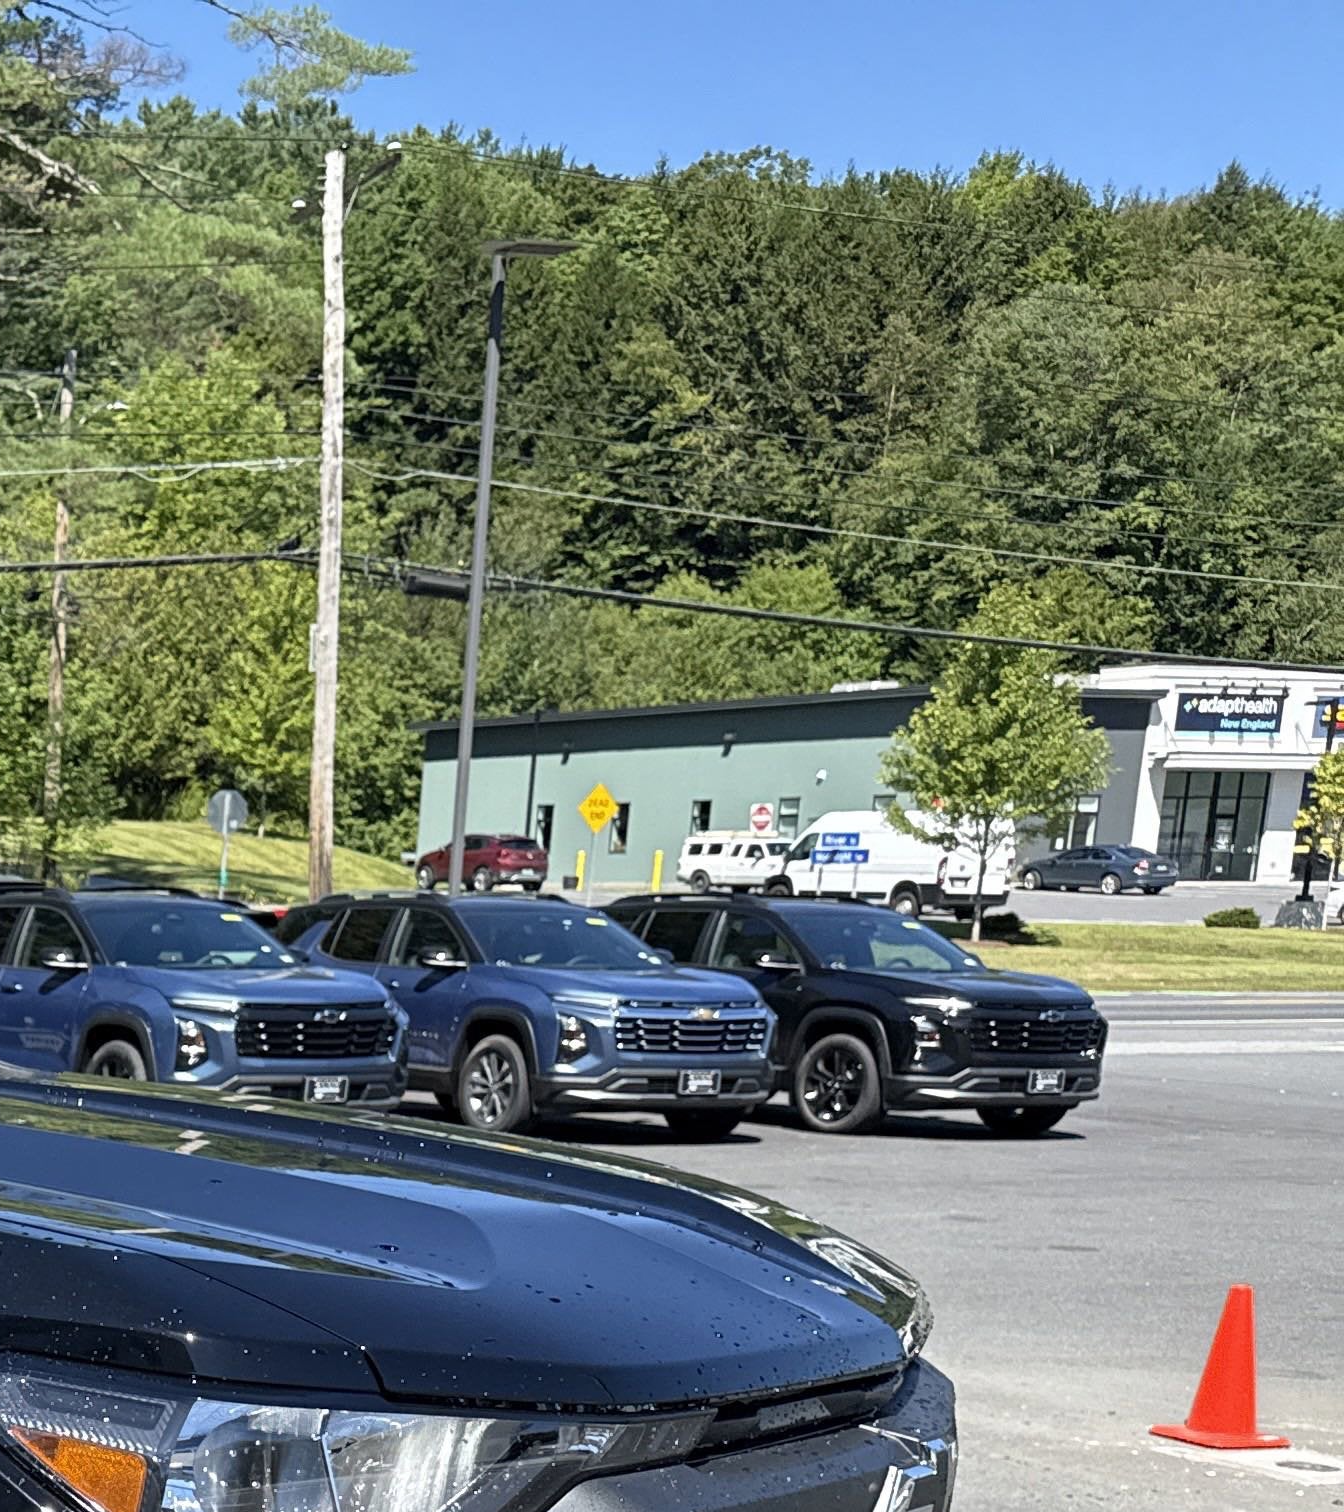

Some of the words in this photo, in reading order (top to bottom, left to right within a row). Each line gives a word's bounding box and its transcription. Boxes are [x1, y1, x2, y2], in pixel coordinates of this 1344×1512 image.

[1198, 696, 1278, 717] adapthealth
[1220, 718, 1240, 729] New
[1241, 718, 1276, 731] England
